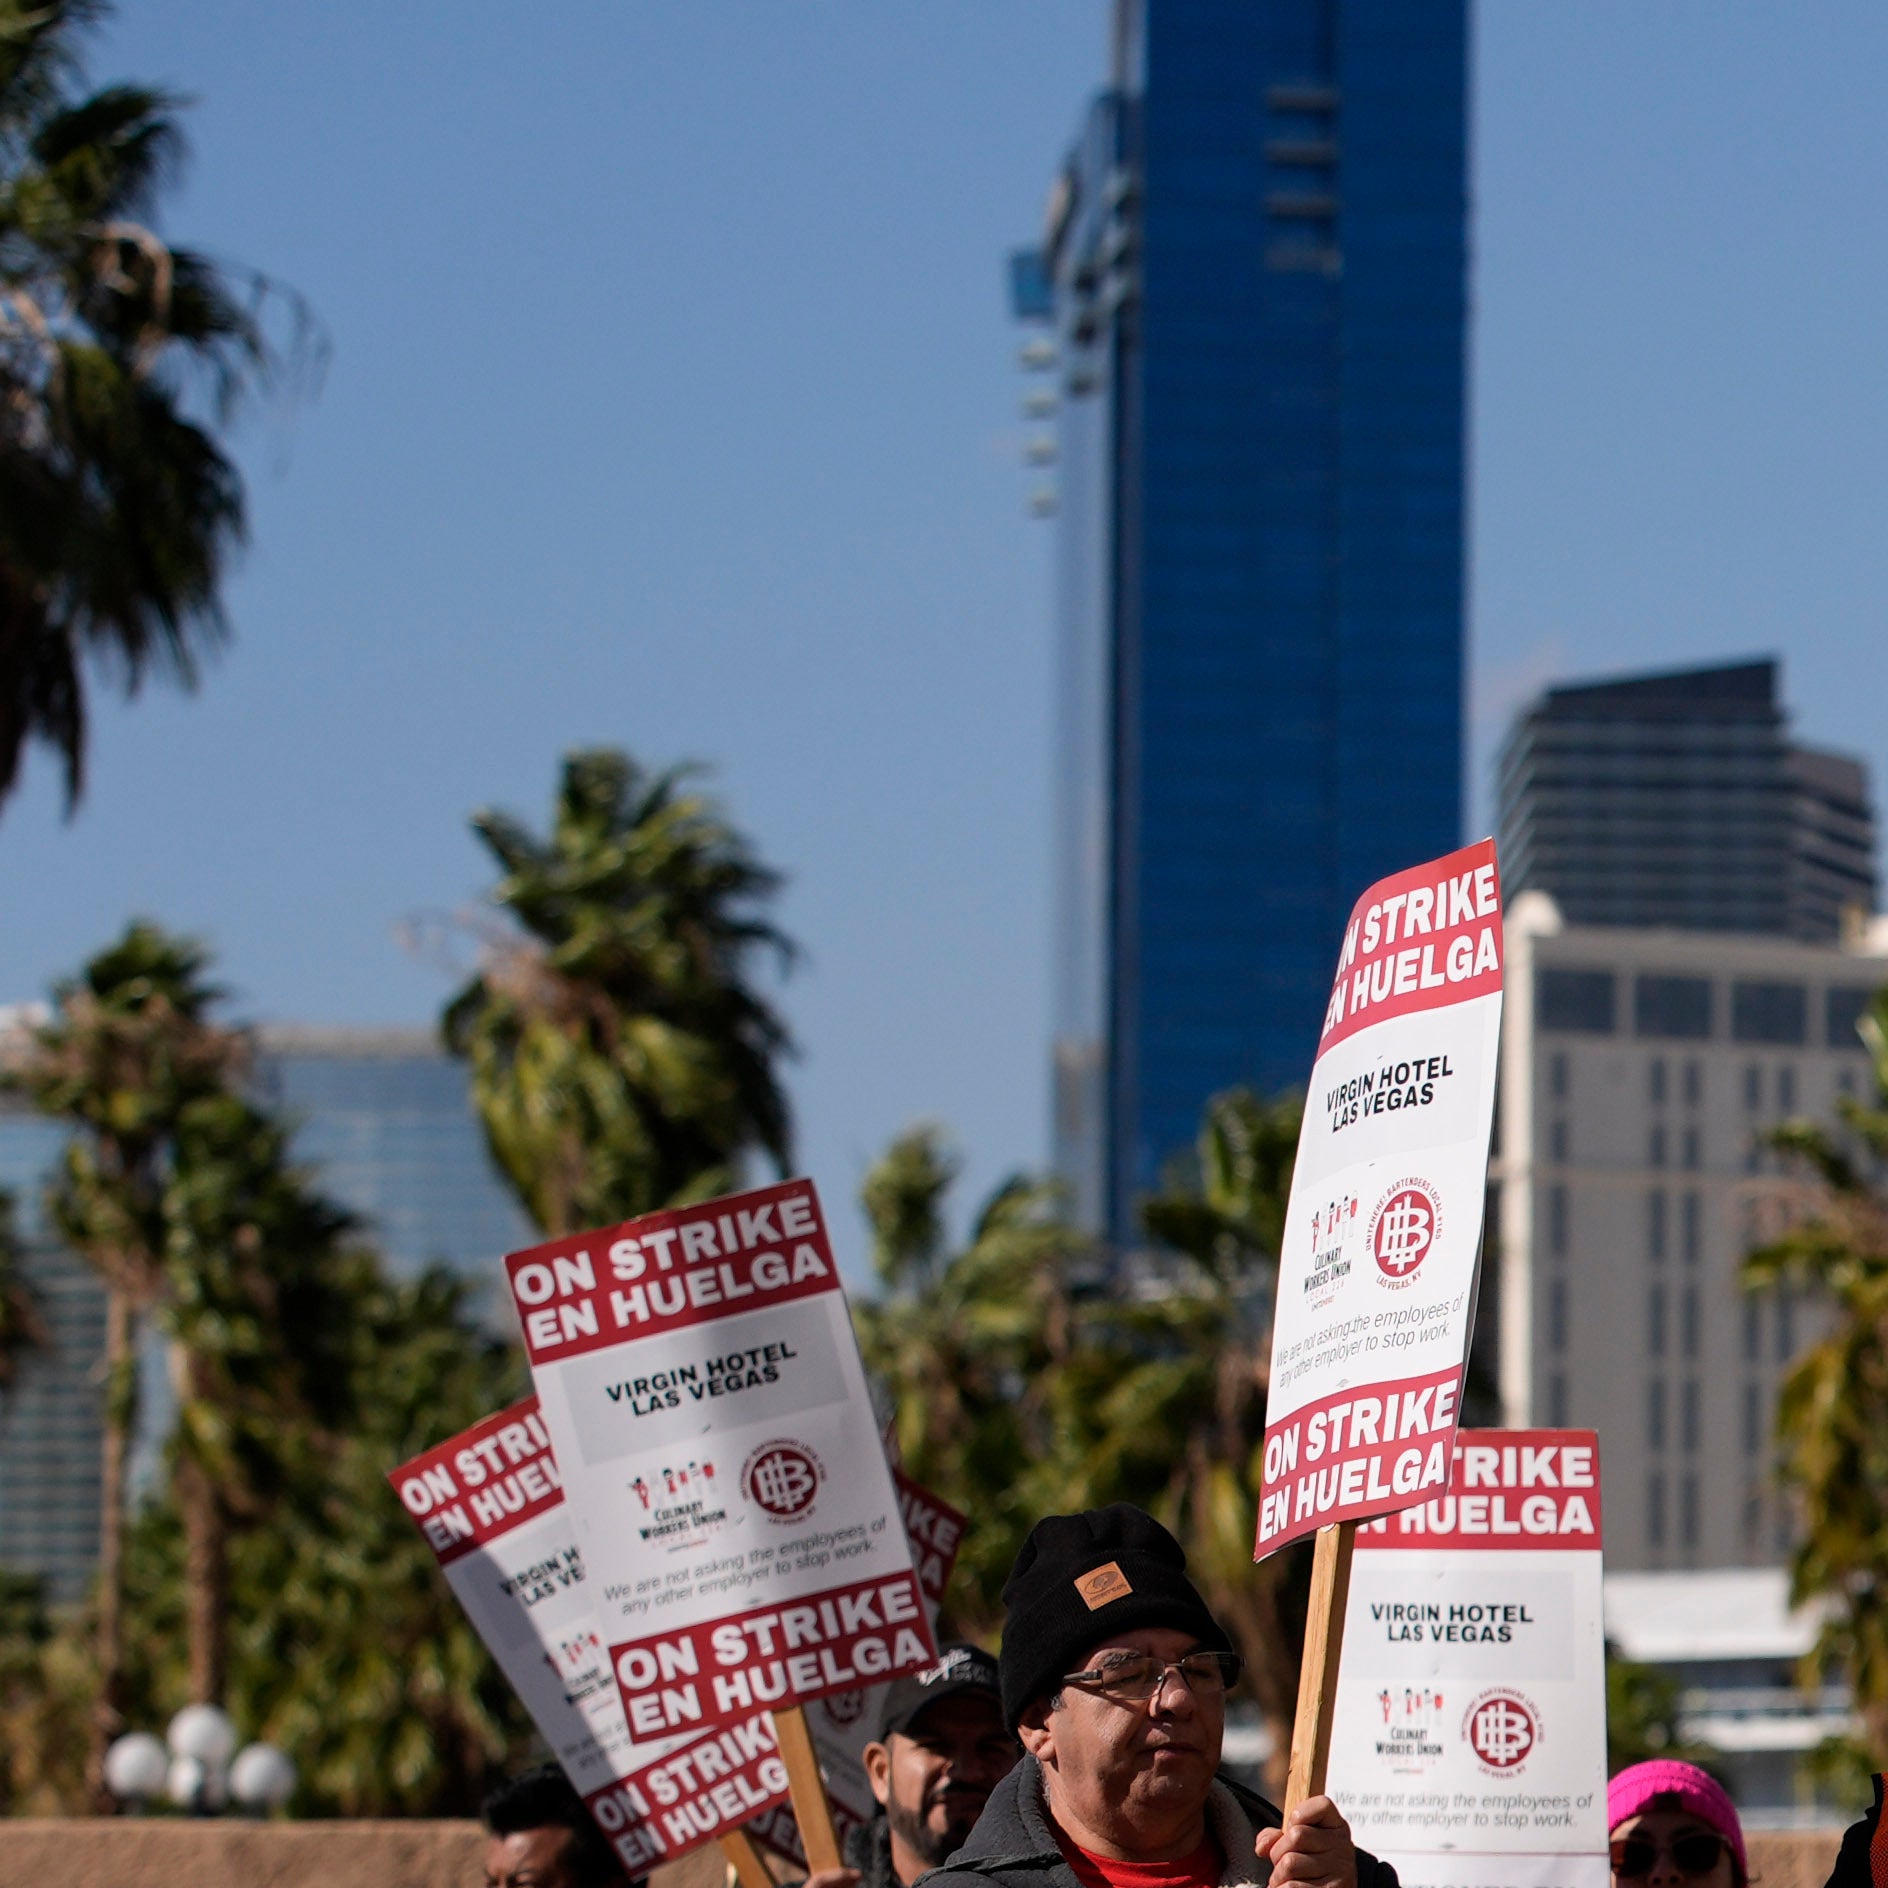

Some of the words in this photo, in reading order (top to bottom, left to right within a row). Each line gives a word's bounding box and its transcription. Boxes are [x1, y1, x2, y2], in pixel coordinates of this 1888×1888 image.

[1362, 863, 1498, 954] STRIKE
[1350, 927, 1499, 1016] HUELGA
[1327, 1071, 1375, 1113] VIRGIN
[1379, 1055, 1454, 1089] HOTEL
[1332, 1102, 1358, 1133] LAS
[1363, 1082, 1434, 1118] VEGAS
[514, 1251, 597, 1305] ON
[608, 1195, 818, 1281] STRIKE
[526, 1298, 600, 1350] EN
[609, 1243, 828, 1329] HUELGA
[1317, 1321, 1352, 1351] asking
[1354, 1314, 1370, 1334] the
[1374, 1301, 1450, 1328] employees
[1452, 1291, 1464, 1312] of
[606, 1365, 698, 1402] VIRGIN
[705, 1341, 797, 1377] HOTEL
[1314, 1340, 1362, 1371] employer
[1365, 1335, 1377, 1352] to
[1382, 1328, 1415, 1351] stop
[1419, 1322, 1450, 1342] work.
[631, 1391, 680, 1417] LAS
[687, 1364, 780, 1401] VEGAS
[400, 1462, 459, 1515] ON
[455, 1413, 552, 1487] STRI
[1264, 1422, 1299, 1485] ON
[1305, 1378, 1458, 1462] STRIKE
[422, 1503, 474, 1552] EN
[470, 1454, 562, 1528] HUEL
[1259, 1485, 1290, 1544] EN
[1295, 1441, 1446, 1522] HUELGA
[1400, 1495, 1595, 1535] HUELGA
[604, 1582, 630, 1602] We
[636, 1576, 661, 1593] are
[666, 1567, 690, 1586] not
[695, 1554, 745, 1581] asking
[750, 1545, 774, 1565] the
[779, 1524, 865, 1558] employees
[871, 1514, 887, 1537] of
[622, 1598, 652, 1616] any
[655, 1586, 694, 1606] other
[699, 1566, 770, 1595] employer
[775, 1558, 791, 1575] to
[796, 1548, 831, 1572] stop
[834, 1539, 873, 1561] work.
[617, 1635, 700, 1690] ON
[711, 1580, 919, 1666] STRIKE
[1371, 1603, 1440, 1622] VIRGIN
[1450, 1604, 1533, 1623] HOTEL
[1388, 1625, 1423, 1642] LAS
[1432, 1625, 1512, 1643] VEGAS
[628, 1683, 702, 1735] EN
[712, 1627, 929, 1713] HUELGA
[592, 1781, 650, 1831] ON
[614, 1822, 667, 1868] EN
[661, 1757, 790, 1846] HUELG
[1360, 1795, 1383, 1806] are
[1387, 1793, 1404, 1806] not
[1407, 1792, 1448, 1809] asking
[1453, 1793, 1477, 1807] the
[1481, 1794, 1570, 1812] employees
[1576, 1793, 1594, 1809] of
[1372, 1811, 1403, 1825] other
[1408, 1813, 1468, 1828] employer
[1473, 1812, 1488, 1826] to
[1494, 1813, 1528, 1830] stop
[1534, 1812, 1578, 1827] work.
